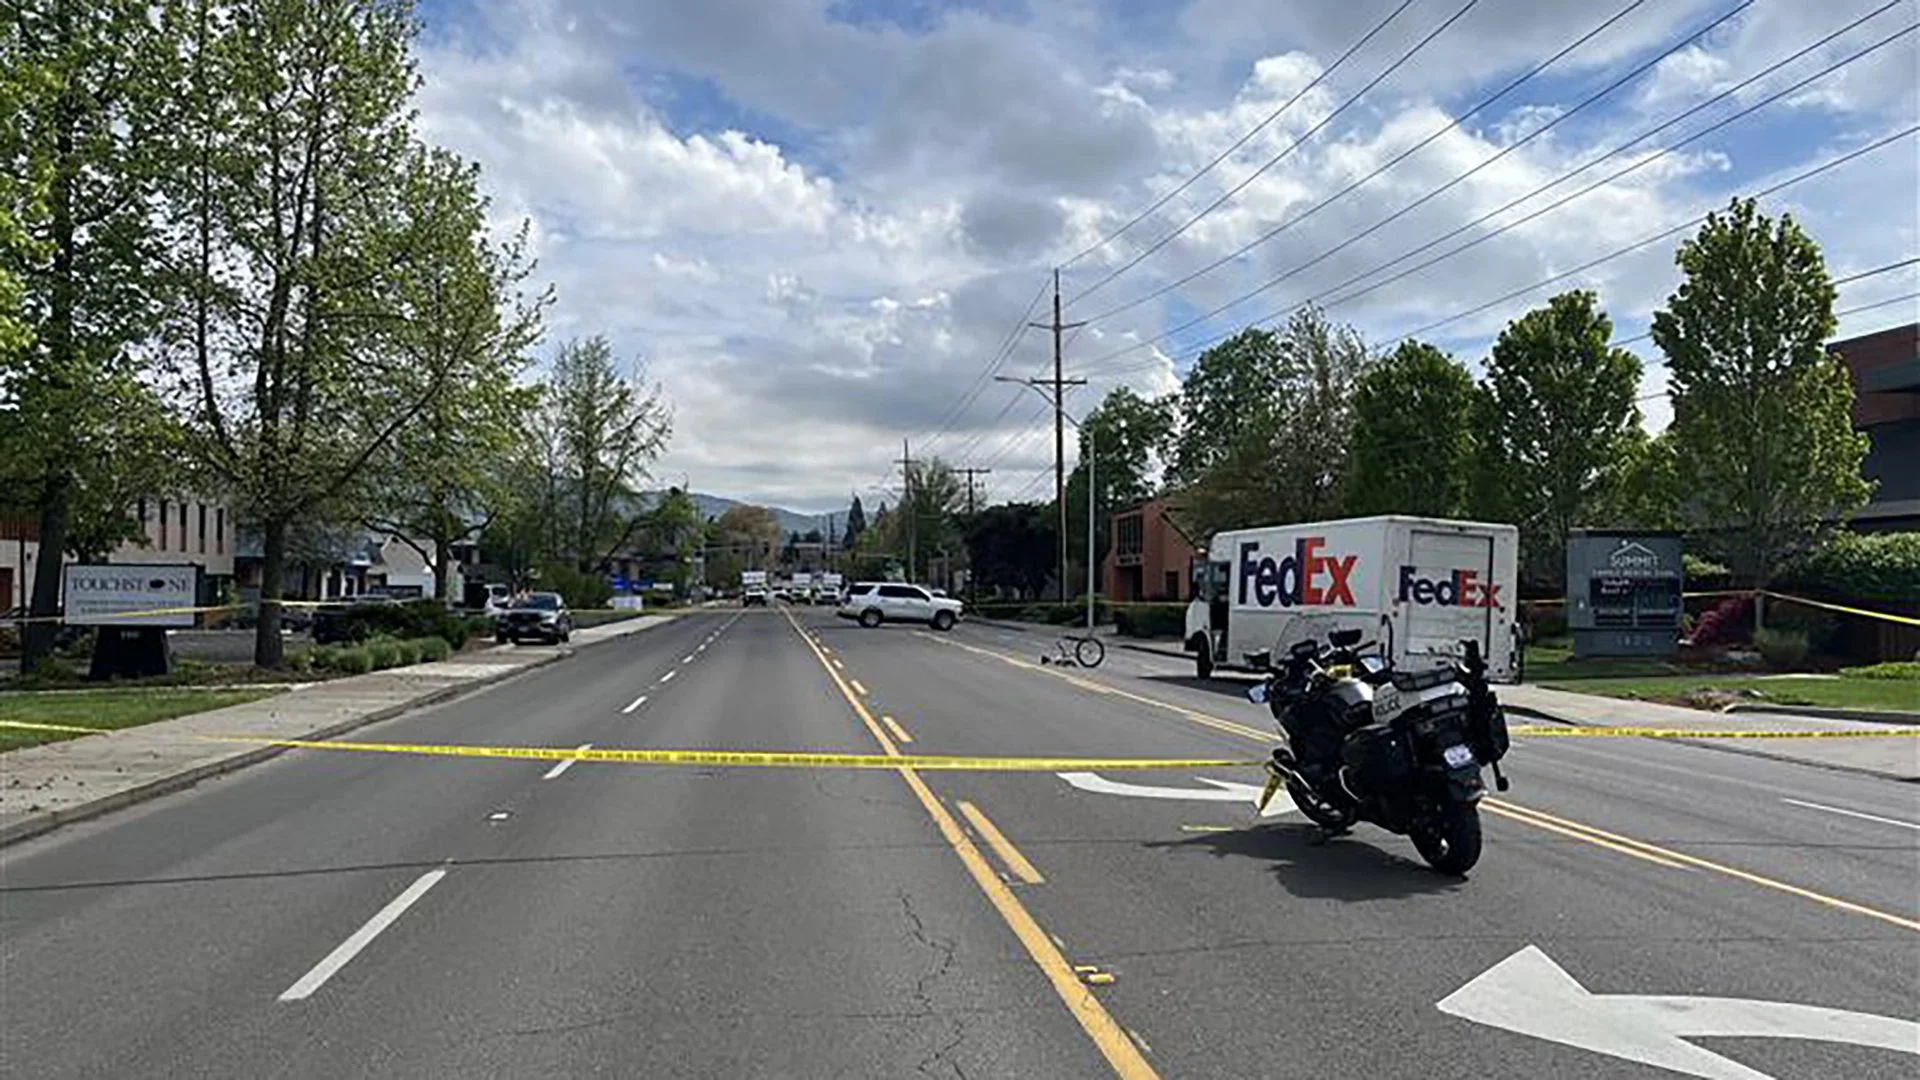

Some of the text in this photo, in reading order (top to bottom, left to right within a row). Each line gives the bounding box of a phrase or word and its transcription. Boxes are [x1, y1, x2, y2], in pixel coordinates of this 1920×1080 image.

[1238, 536, 1358, 608] FedEx
[1611, 556, 1658, 567] SUMMIT
[1399, 565, 1503, 608] FedEx
